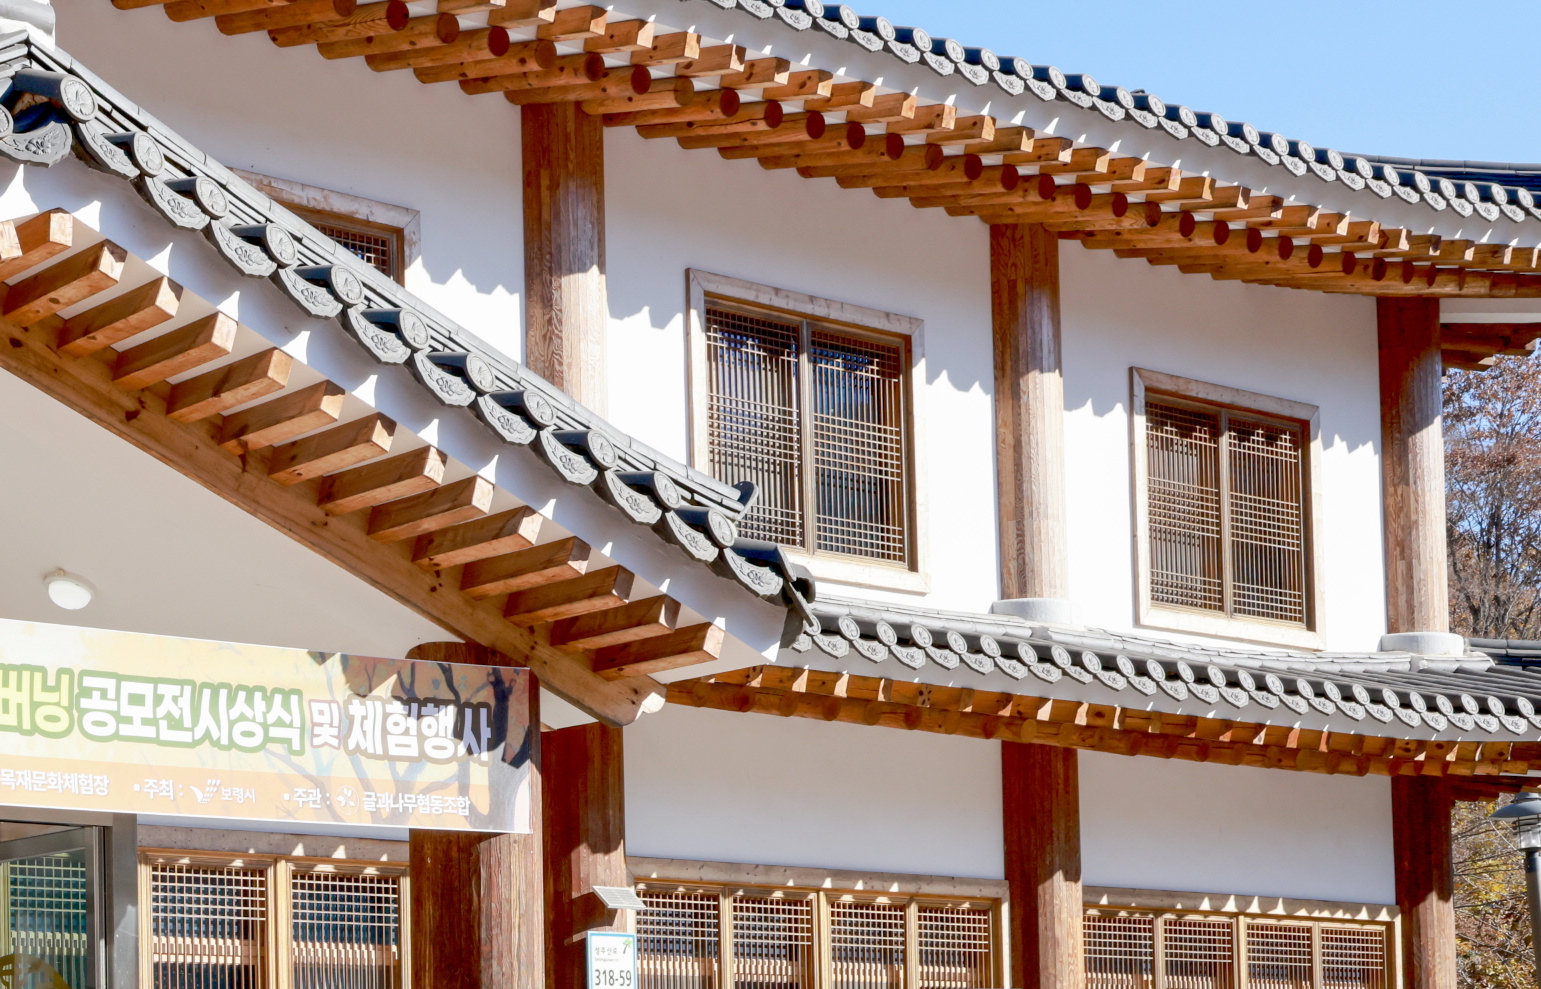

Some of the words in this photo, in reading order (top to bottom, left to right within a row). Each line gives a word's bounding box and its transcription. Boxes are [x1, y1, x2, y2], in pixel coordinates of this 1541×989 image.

[79, 675, 302, 752] 공모전시상식
[309, 701, 341, 748] 및
[346, 698, 492, 763] 체험행사
[143, 778, 174, 801] 주최
[220, 786, 256, 804] 보령시
[292, 787, 322, 809] 주관
[362, 790, 471, 817] 글과나무협동조합
[594, 969, 632, 987] 318-59
